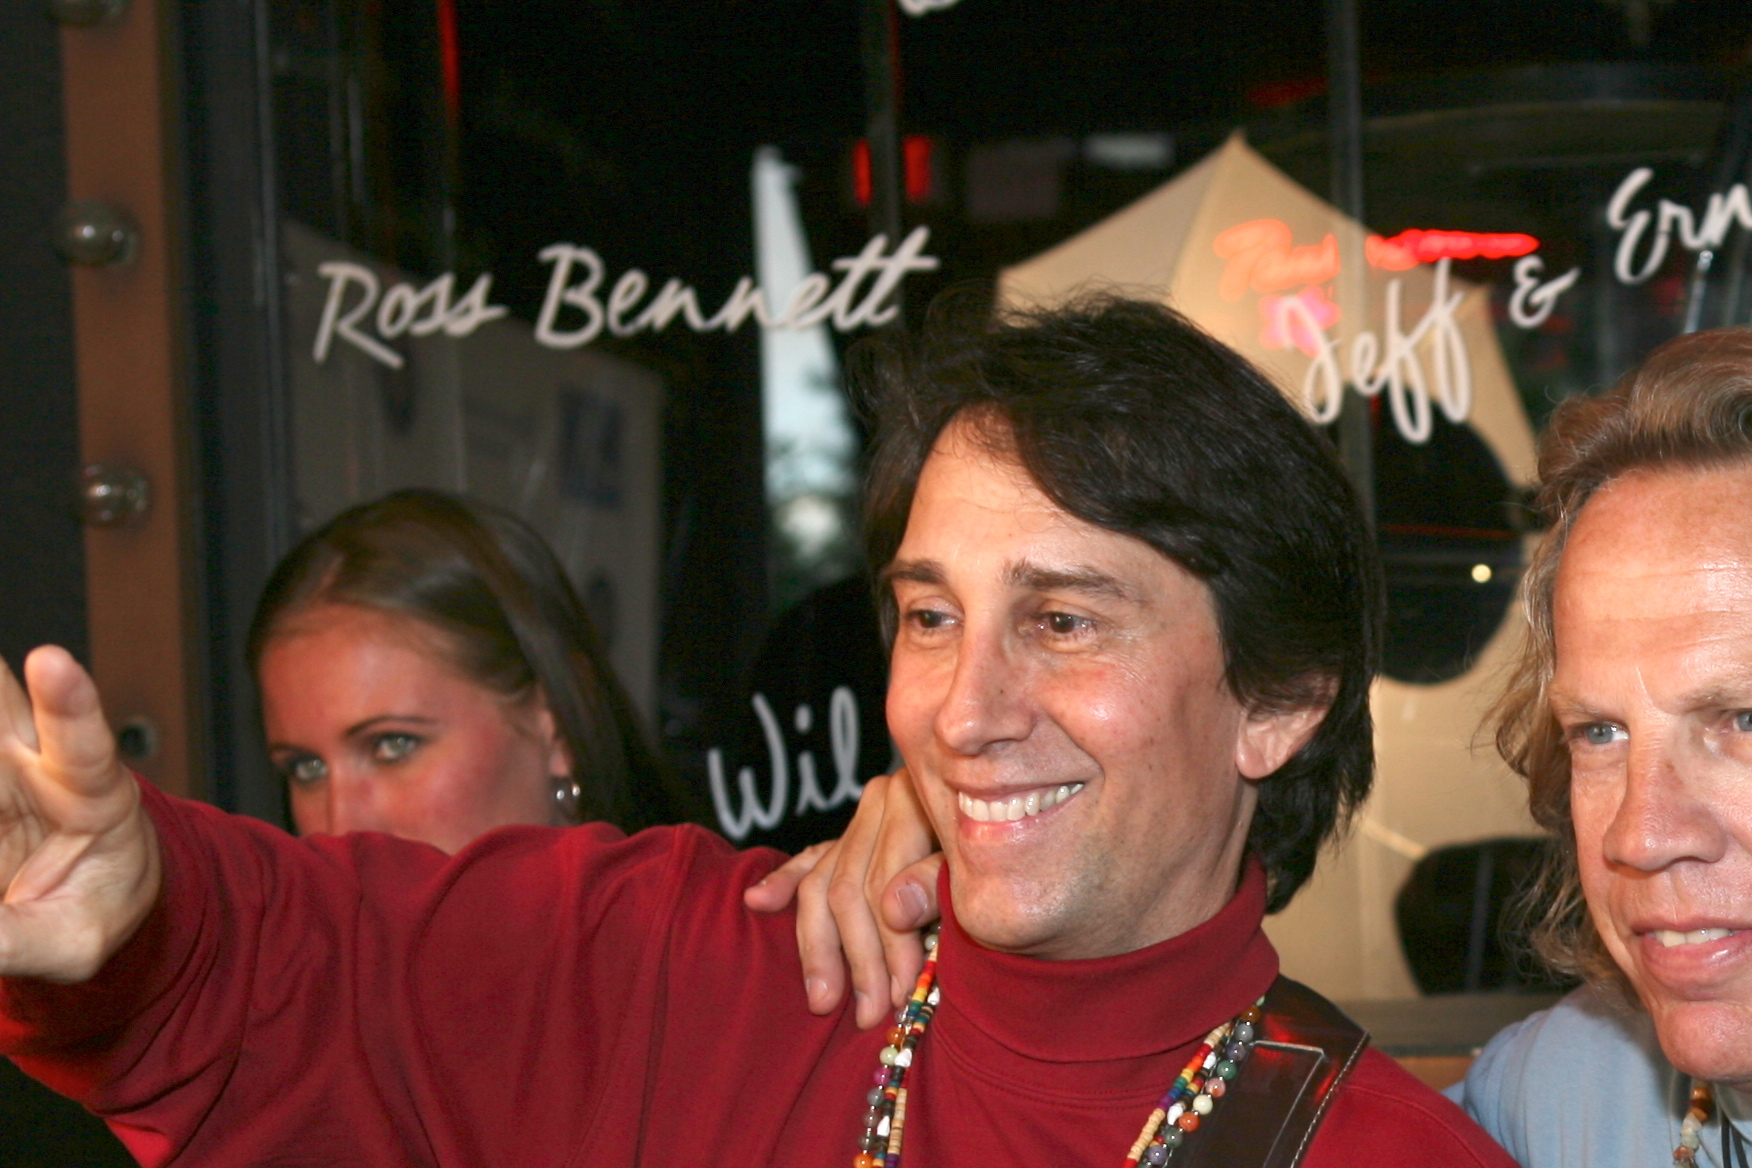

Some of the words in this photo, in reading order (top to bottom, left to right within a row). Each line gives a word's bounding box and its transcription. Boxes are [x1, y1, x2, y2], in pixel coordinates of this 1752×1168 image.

[312, 260, 509, 369] Ross
[535, 226, 941, 349] Bennett
[1278, 255, 1467, 444] Jeff
[1508, 253, 1582, 328] &
[706, 686, 864, 841] Wil
